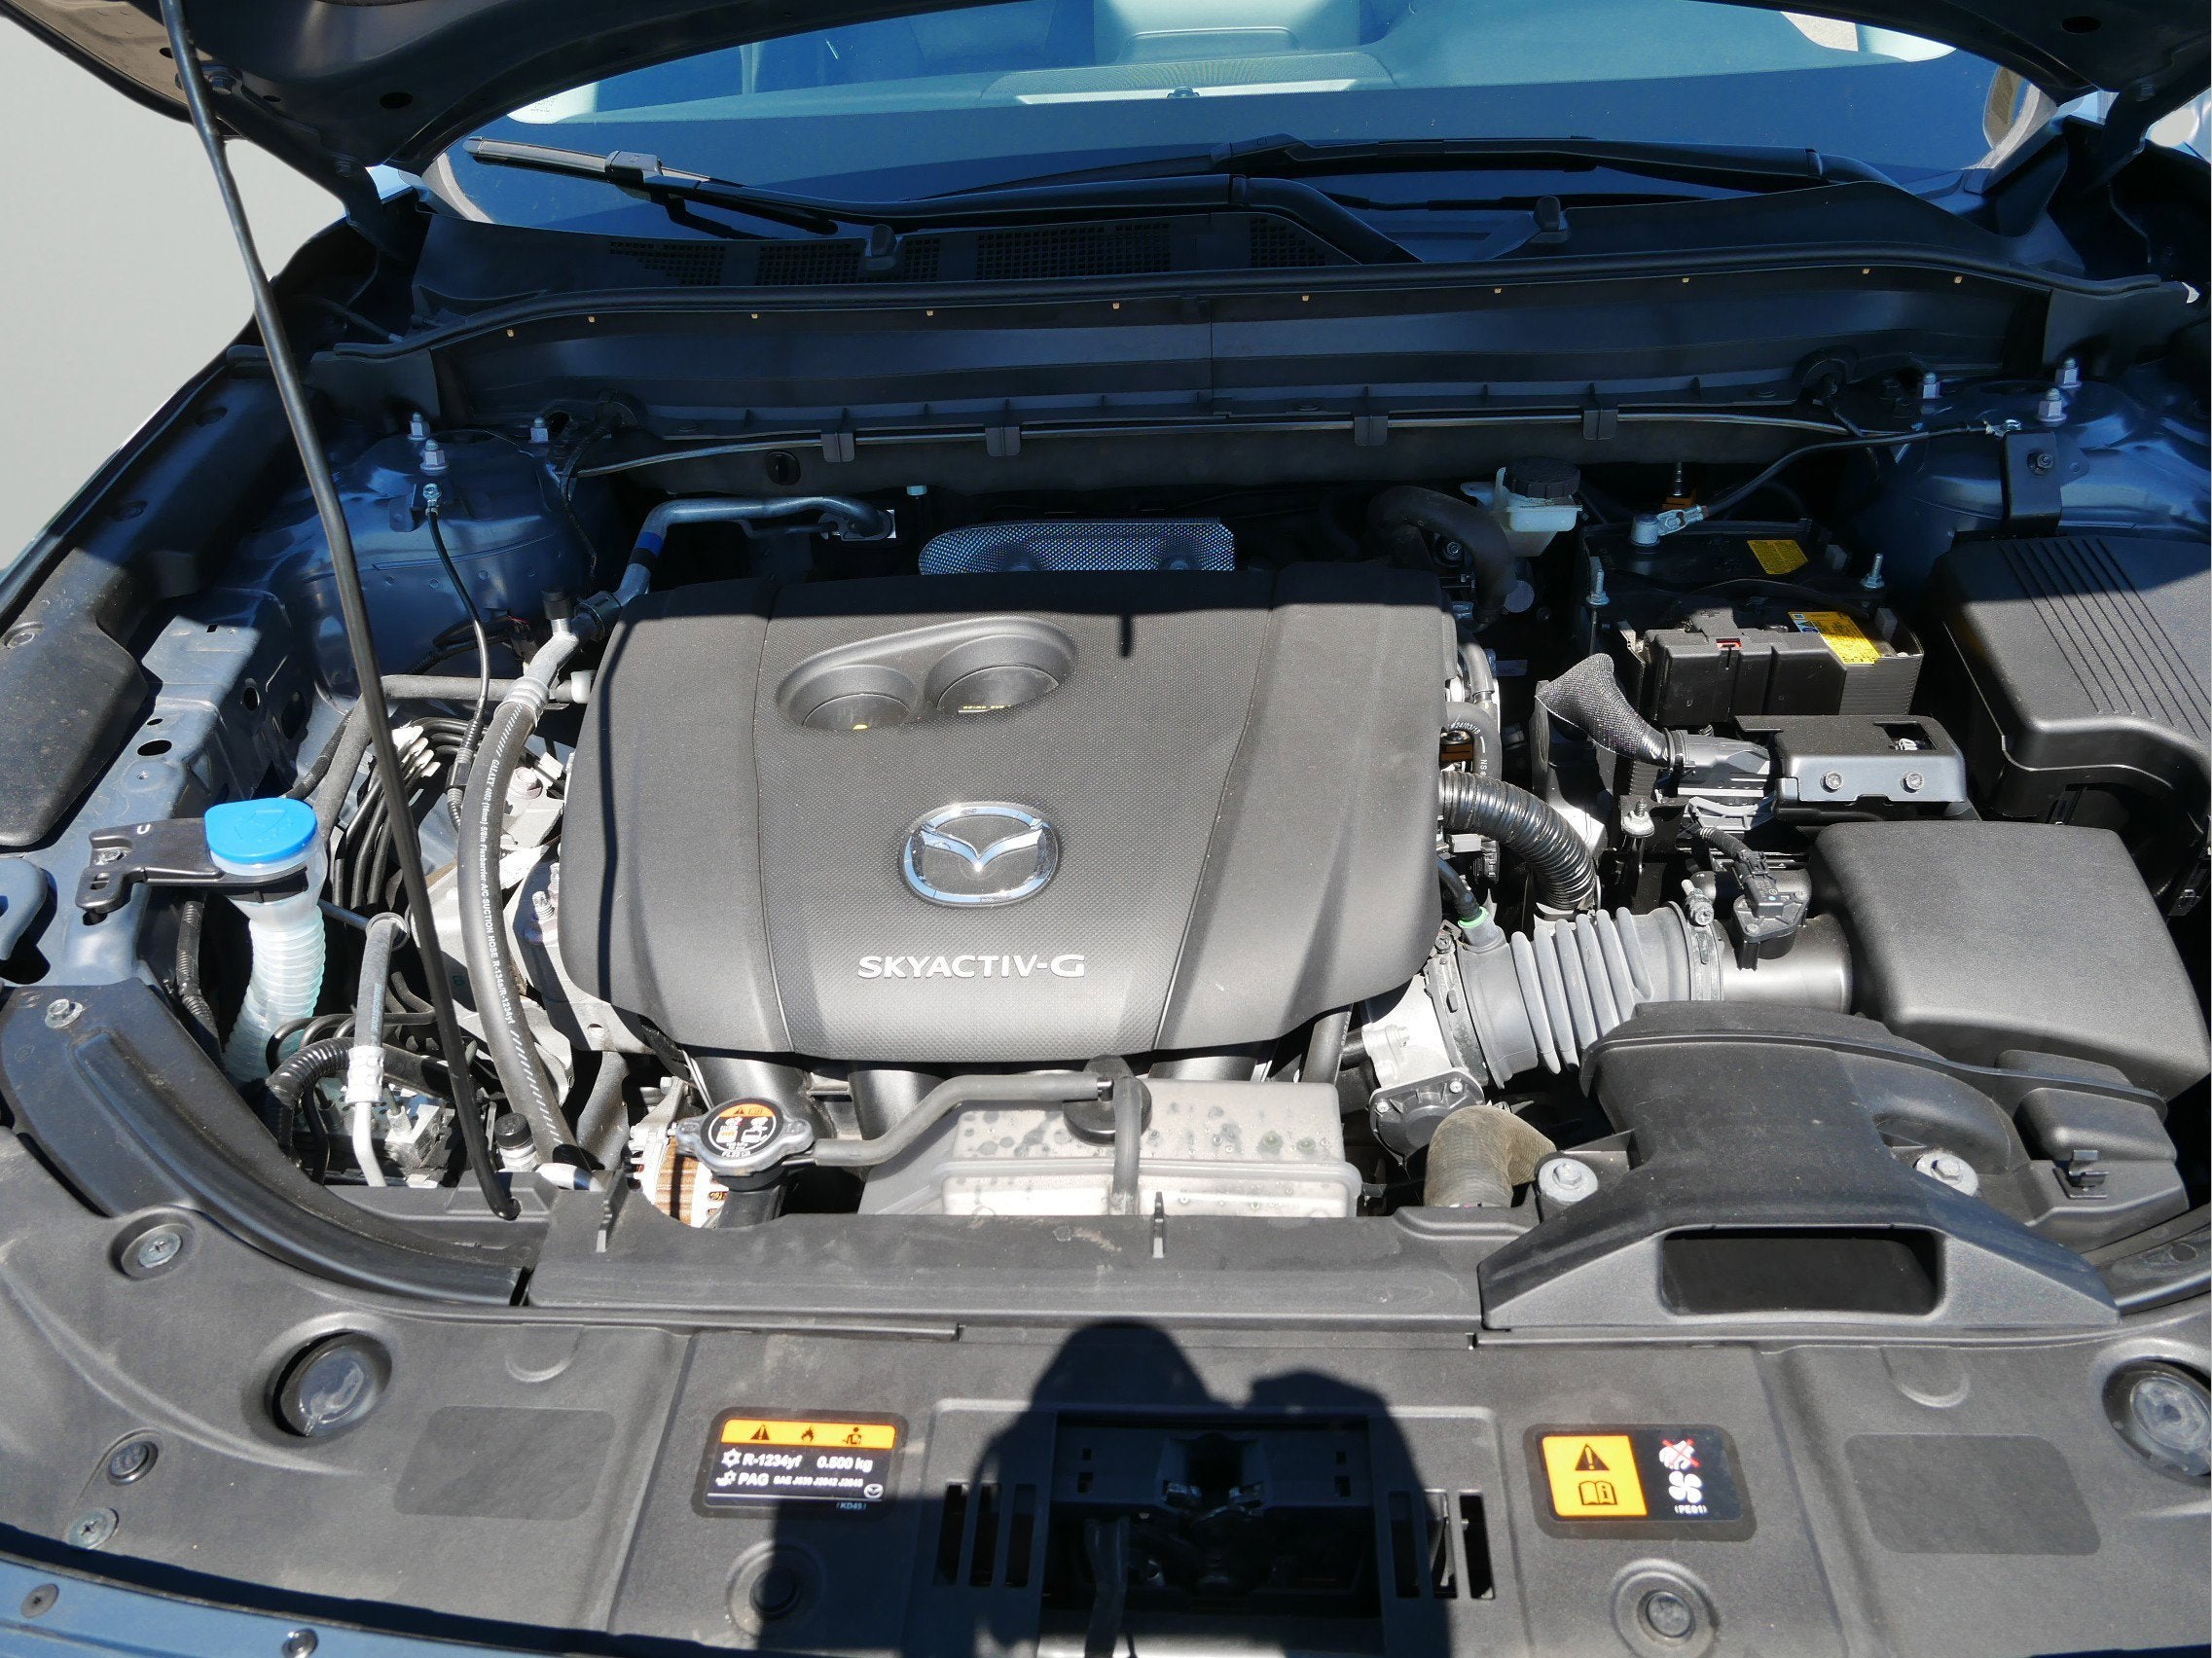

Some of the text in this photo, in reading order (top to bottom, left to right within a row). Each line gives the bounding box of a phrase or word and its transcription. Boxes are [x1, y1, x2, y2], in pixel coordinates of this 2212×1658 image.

[487, 759, 500, 787] GALAXY
[482, 898, 494, 934] SUCTION
[488, 935, 498, 958] HOSE
[857, 954, 1085, 979] SKYACTIV-G
[743, 1453, 874, 1473] R-1234yf 0.500 kg
[738, 1472, 770, 1486] PAG
